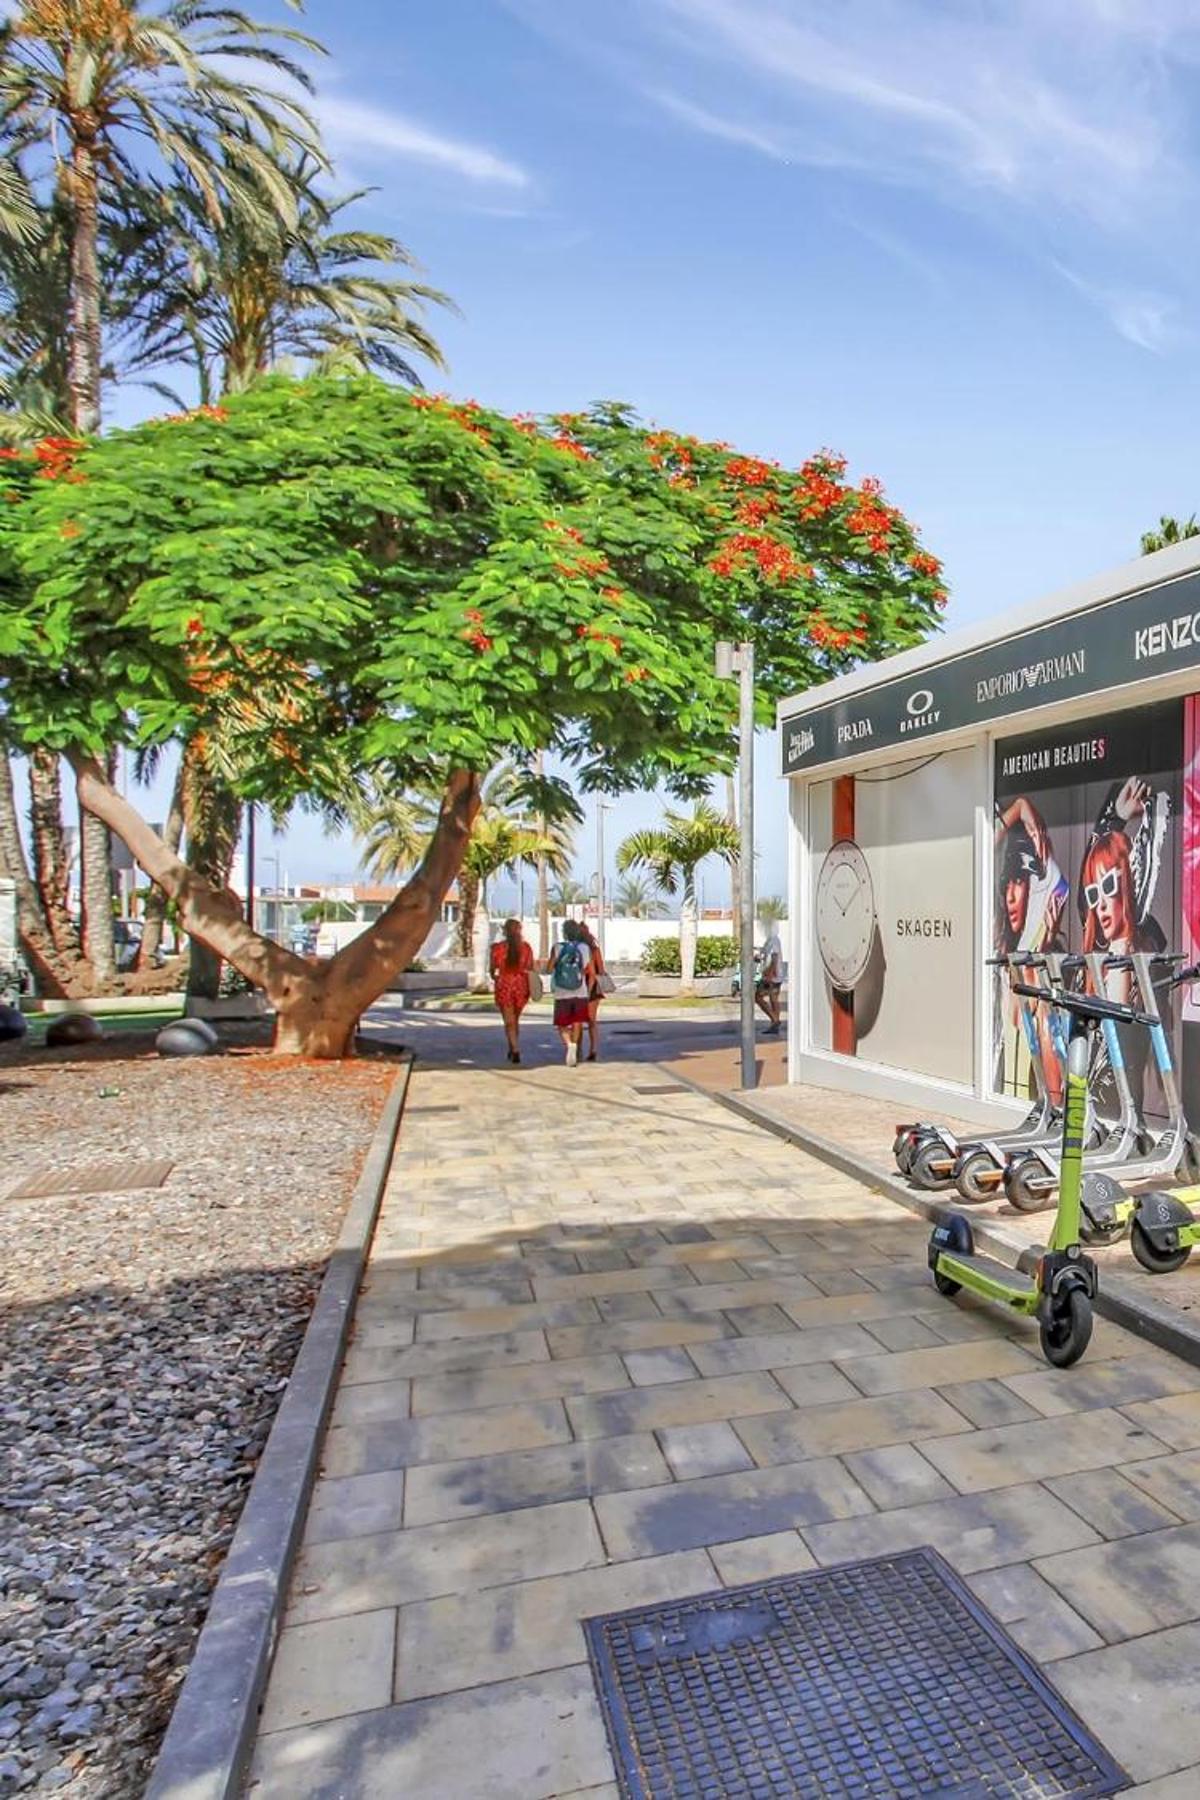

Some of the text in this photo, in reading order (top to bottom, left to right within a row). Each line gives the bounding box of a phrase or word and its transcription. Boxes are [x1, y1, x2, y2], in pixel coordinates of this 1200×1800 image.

[976, 649, 1086, 704] EMPORIO ARMANI
[837, 717, 873, 744] PRADA
[899, 710, 941, 734] OAKLEY
[1002, 738, 1106, 777] AMERICAN BEAUTIES
[896, 918, 953, 938] SKAGEN
